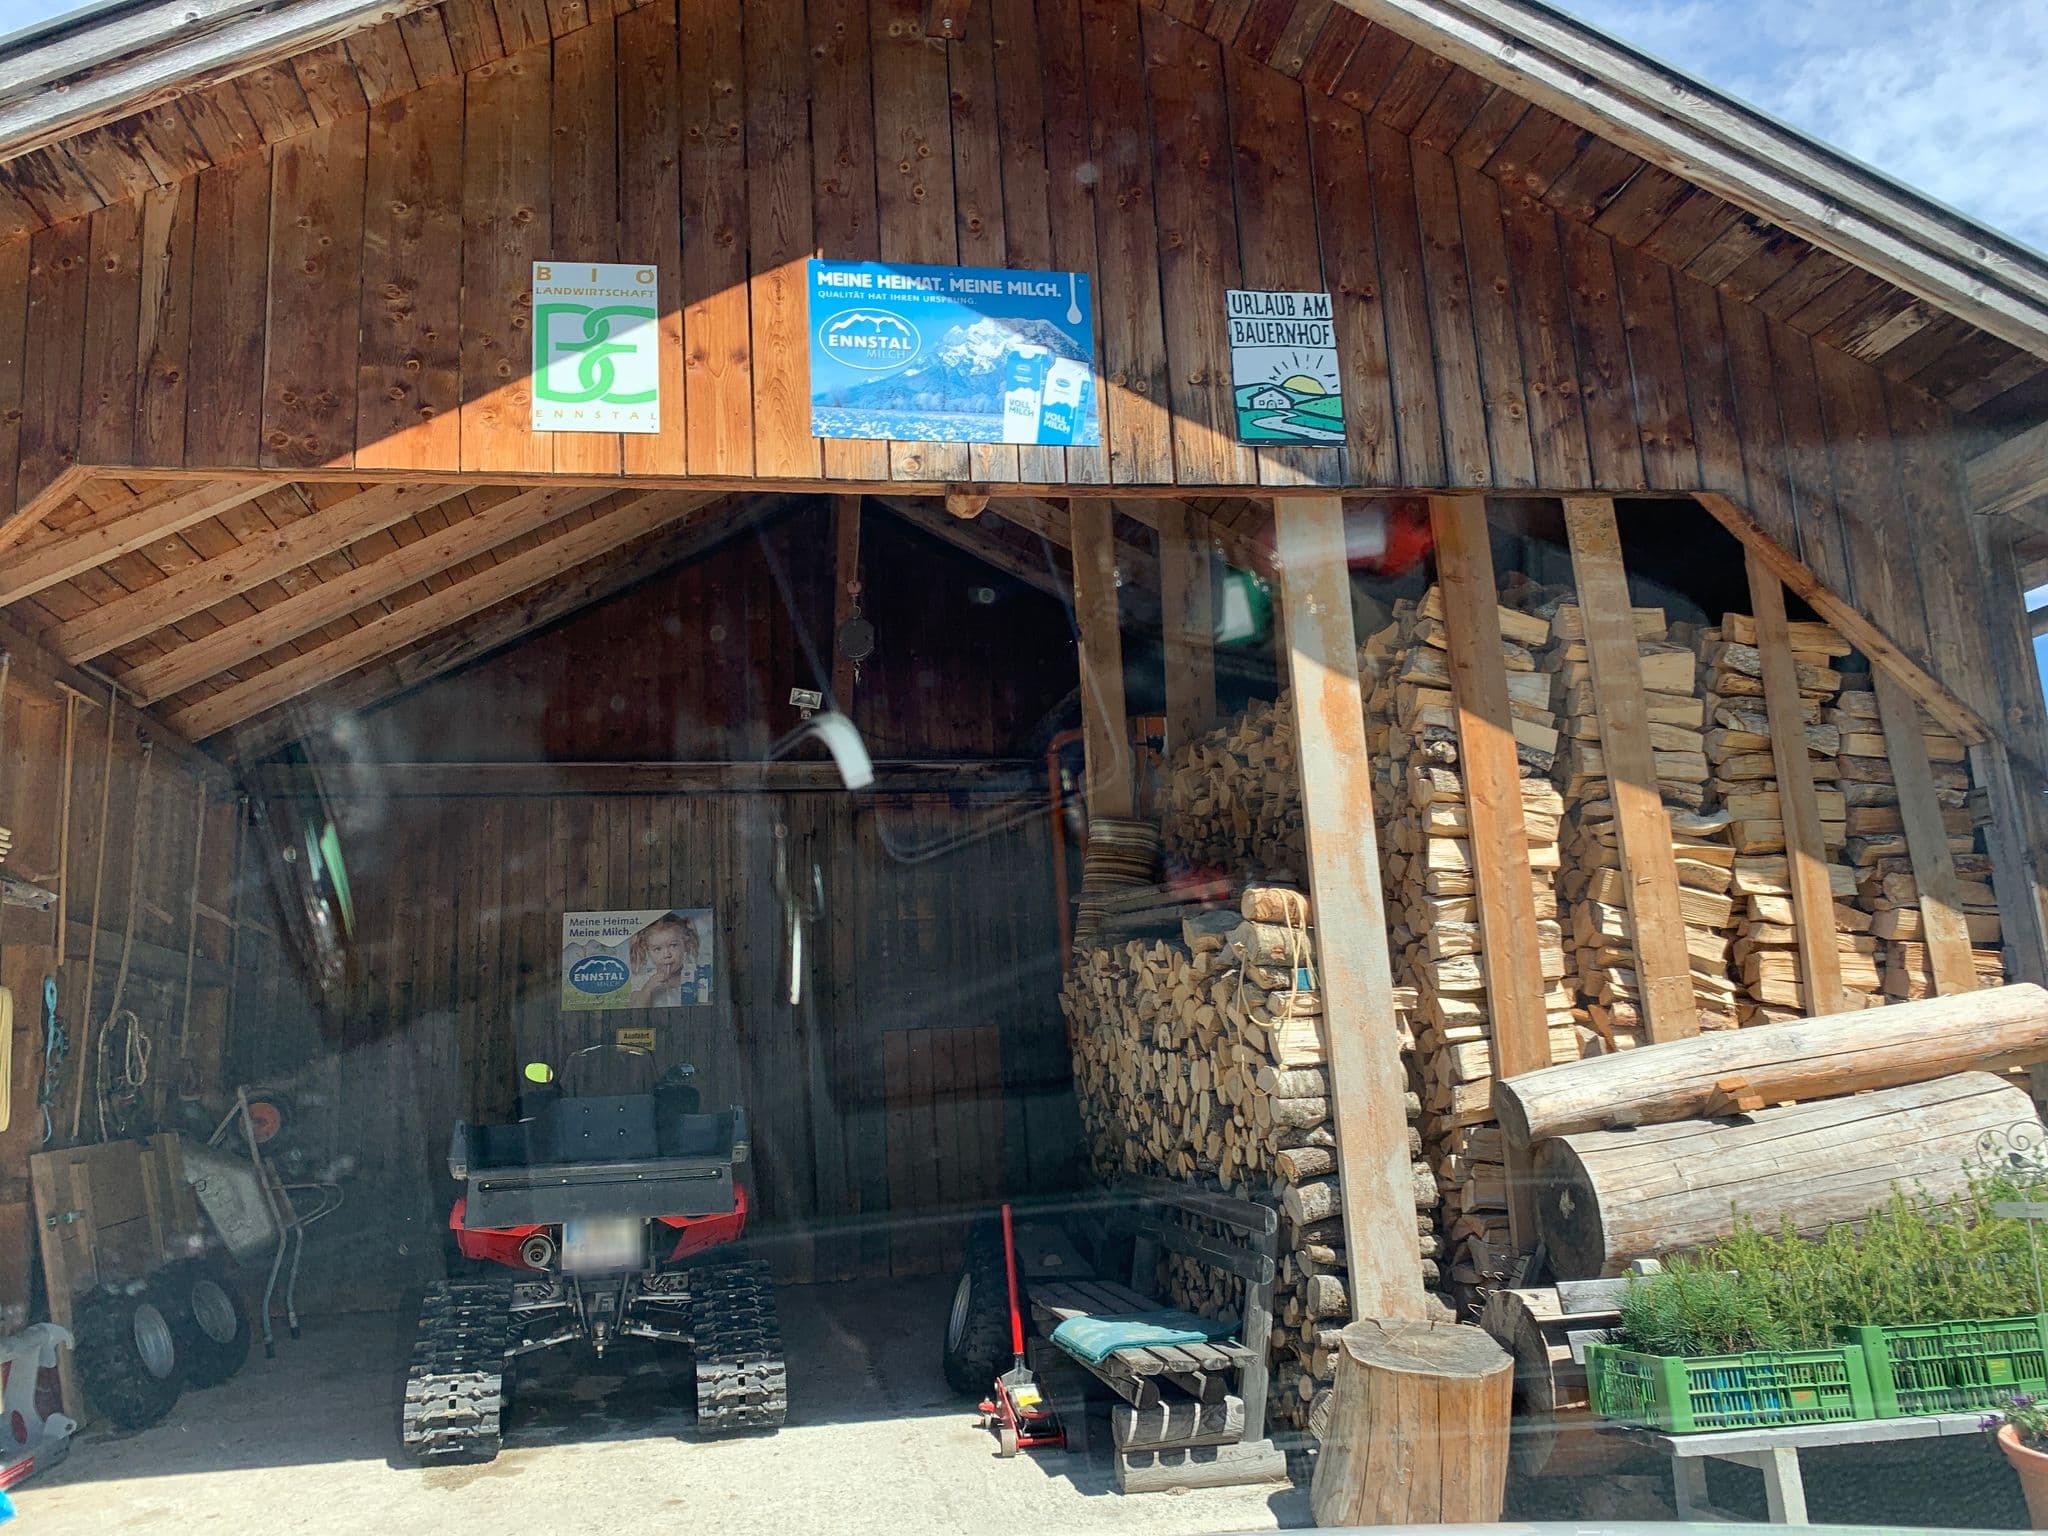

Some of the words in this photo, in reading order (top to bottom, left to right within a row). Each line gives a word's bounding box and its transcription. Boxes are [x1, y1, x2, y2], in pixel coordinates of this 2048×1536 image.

[536, 266, 655, 284] BIO
[817, 271, 872, 288] MEINE
[877, 275, 944, 291] HEIMAT.
[950, 279, 1003, 295] MEINE
[1007, 281, 1061, 297] MILCH.
[536, 287, 656, 298] LANDWIRTSCHAFT
[818, 290, 865, 299] QUALITÄT
[890, 293, 920, 302] IHREN
[922, 295, 977, 305] URSPRUNG.
[1231, 293, 1296, 316] URLAUB
[1303, 295, 1329, 317] AM
[1235, 321, 1330, 344] BAUERNHOF
[828, 334, 911, 350] ENNSTAL
[866, 349, 905, 359] MILCH
[536, 410, 656, 420] ENNSTAL
[1009, 406, 1034, 417] MILCH
[569, 917, 600, 926] Meine
[603, 916, 643, 926] Heimat.
[569, 928, 600, 937] Meine
[602, 926, 632, 936] Milch.
[574, 972, 625, 982] ENNSTAL
